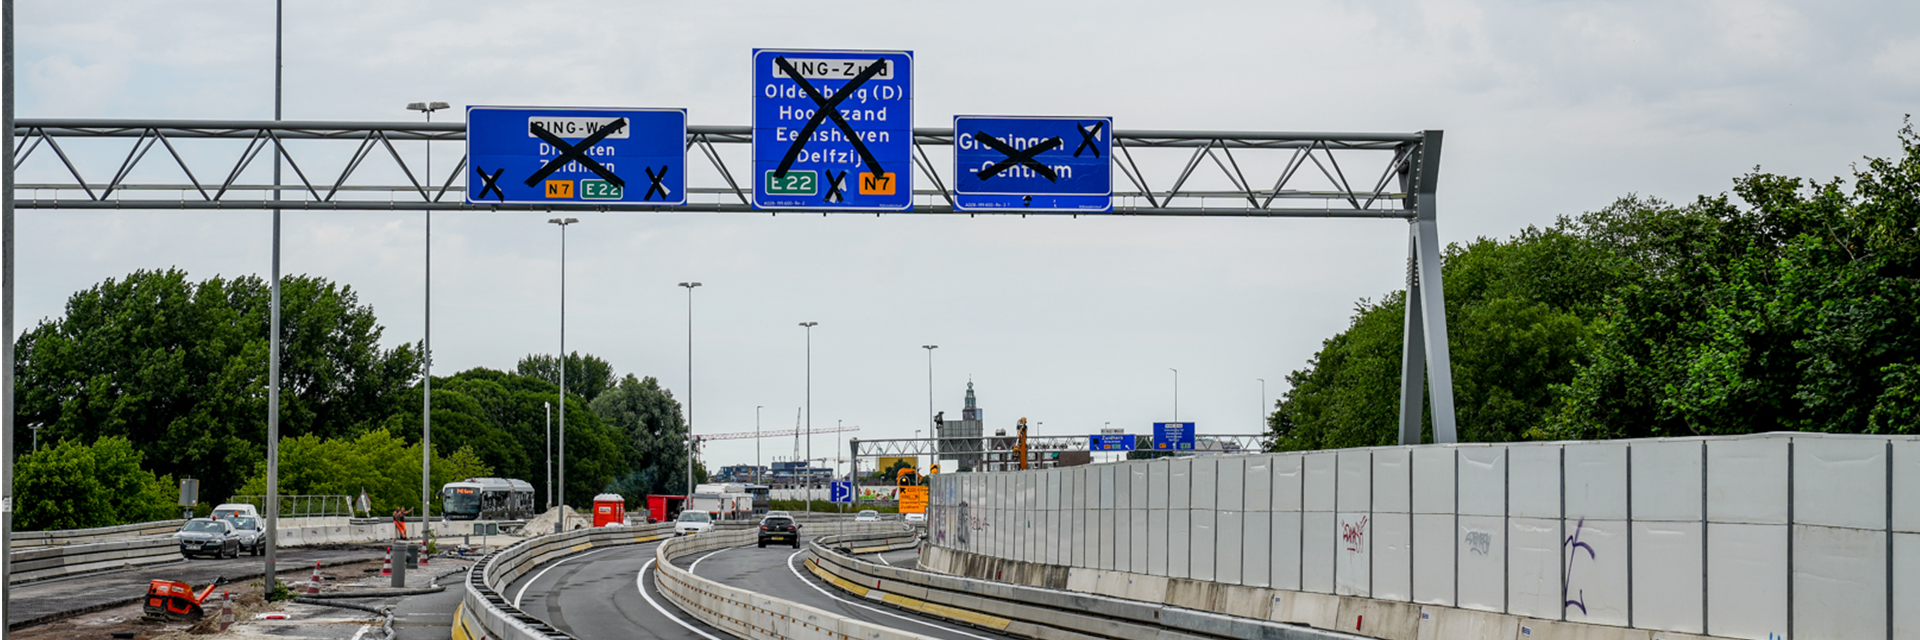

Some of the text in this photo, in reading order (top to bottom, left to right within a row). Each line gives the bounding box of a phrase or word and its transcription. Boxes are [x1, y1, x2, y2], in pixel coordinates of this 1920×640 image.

[764, 83, 868, 104] Oldebg
[779, 105, 887, 125] Hoozand
[539, 142, 616, 157] Drten
[797, 148, 862, 168] Delfzij
